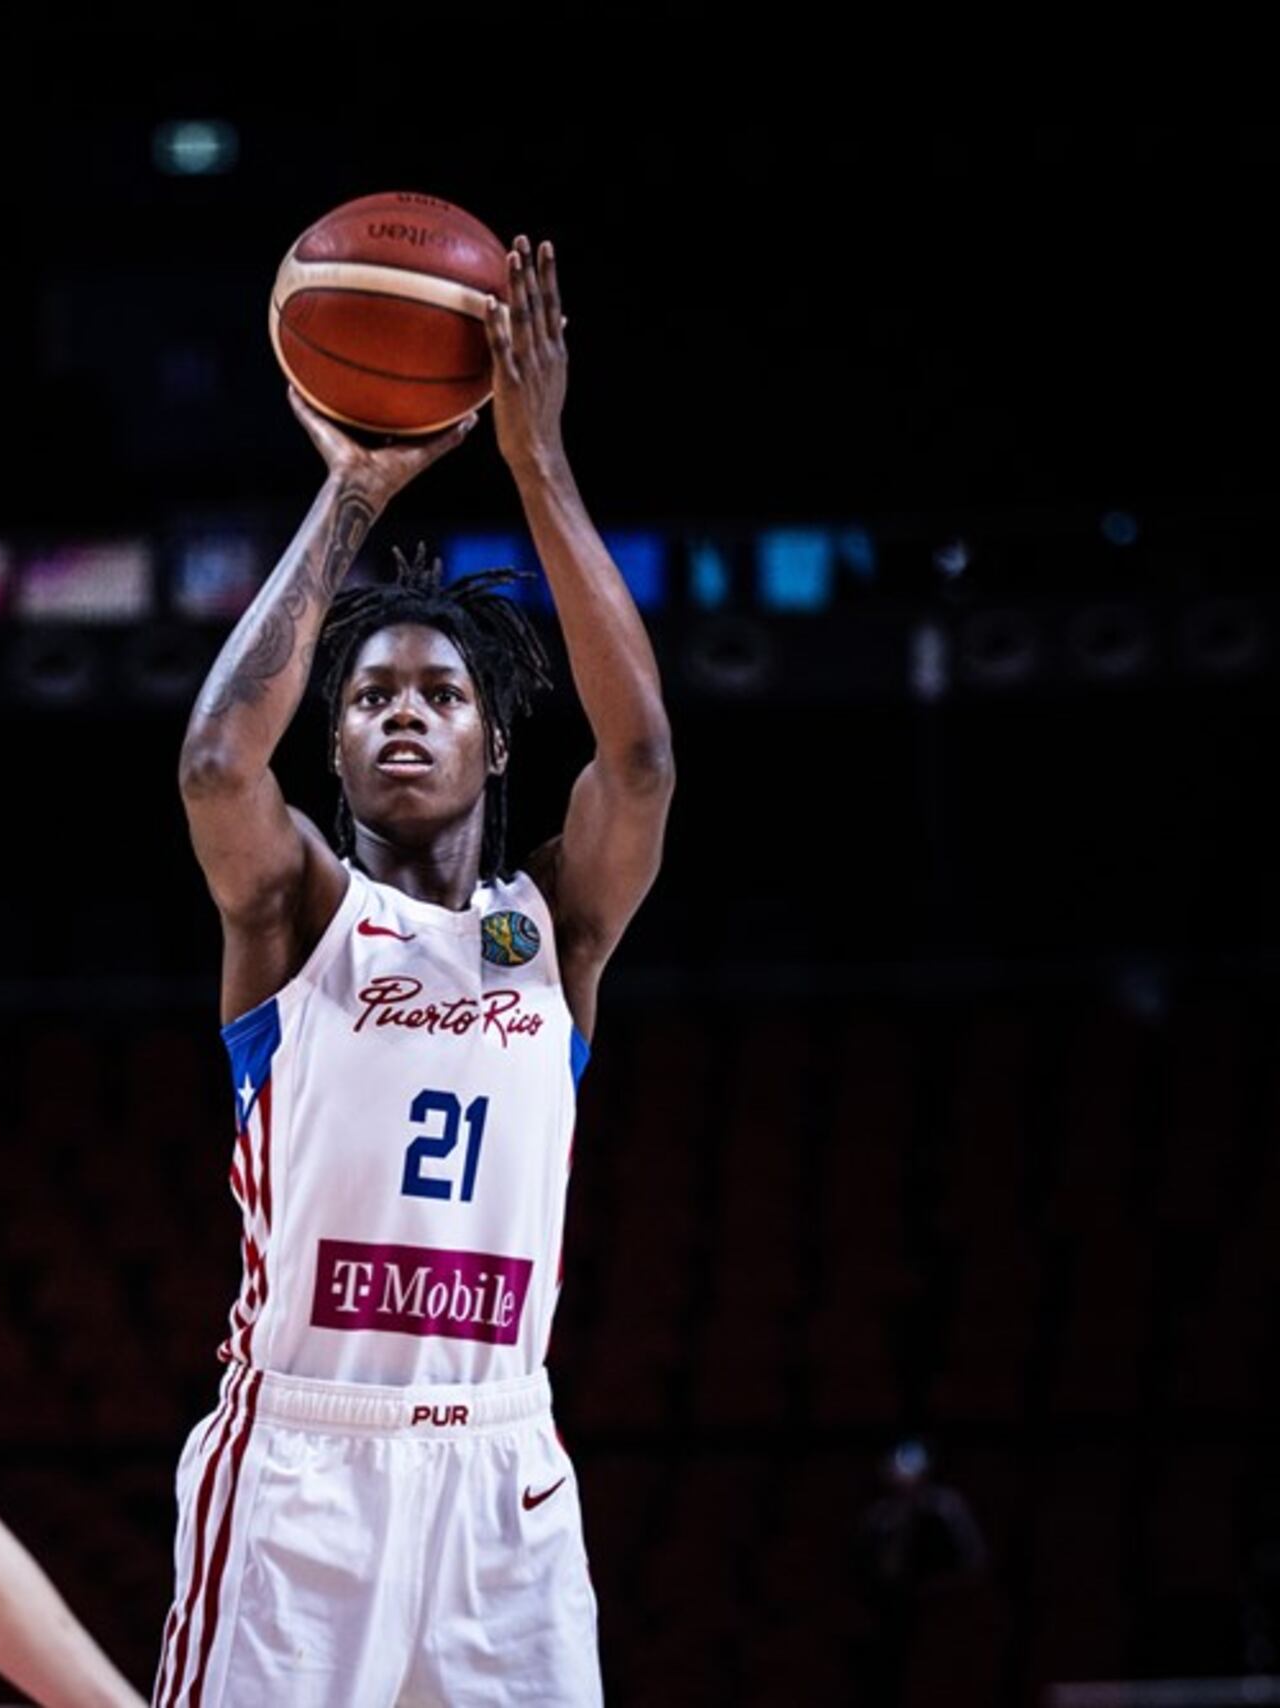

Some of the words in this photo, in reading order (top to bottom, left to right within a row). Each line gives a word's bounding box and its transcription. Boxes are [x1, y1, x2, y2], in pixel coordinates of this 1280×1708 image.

[353, 975, 480, 1034] Puerto
[482, 990, 544, 1048] Rico
[401, 1088, 489, 1202] 21
[411, 1406, 469, 1427] PUR
